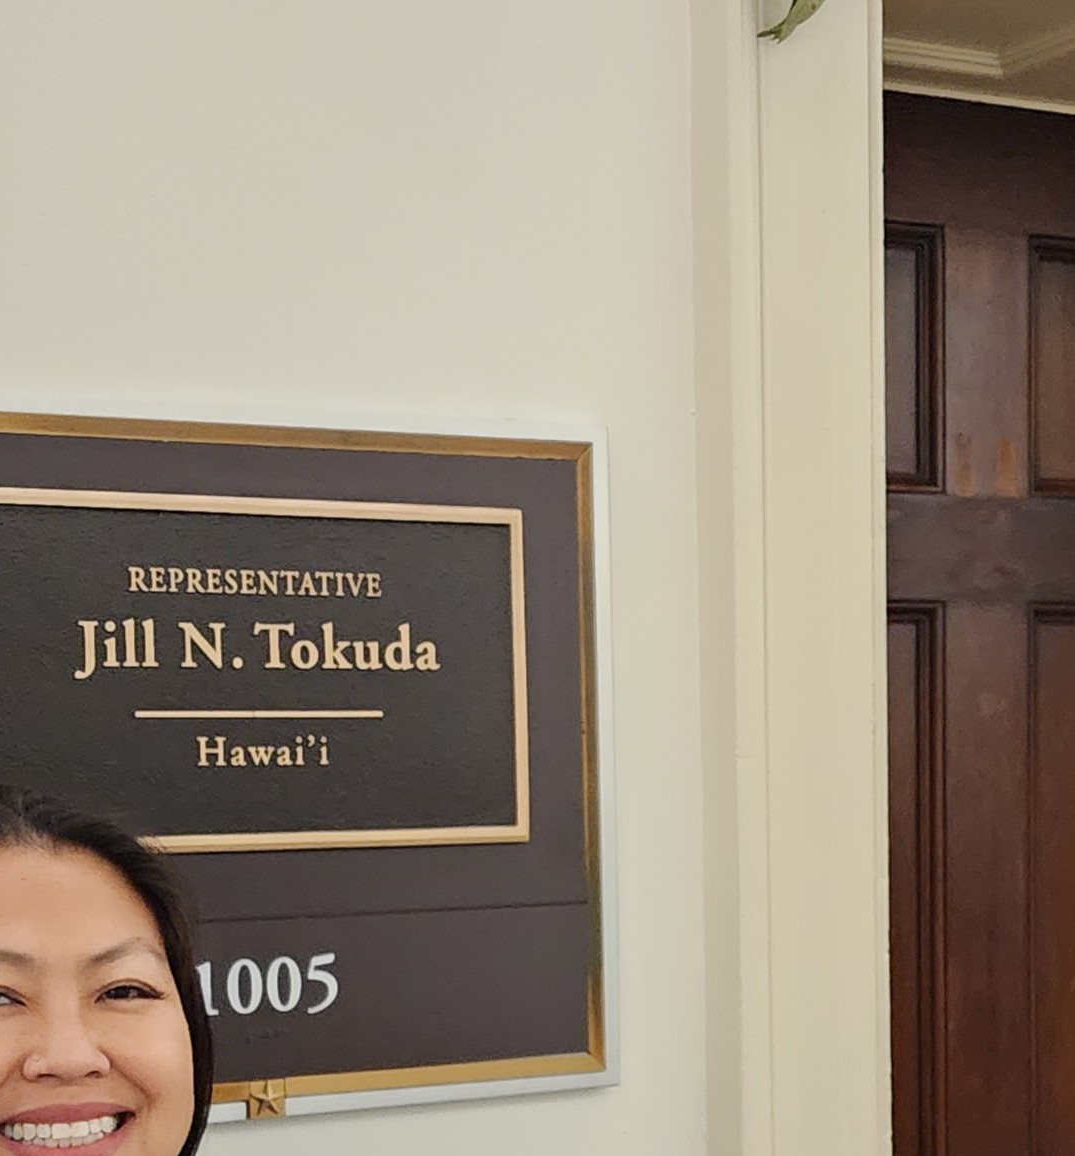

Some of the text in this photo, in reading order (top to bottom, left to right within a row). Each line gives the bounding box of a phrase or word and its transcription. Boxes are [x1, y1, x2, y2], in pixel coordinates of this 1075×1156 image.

[128, 566, 382, 597] REPRESENTATIVE
[74, 618, 441, 679] Jill N. Tokuda
[196, 734, 329, 767] Hawai'i
[195, 952, 338, 1016] 1005
